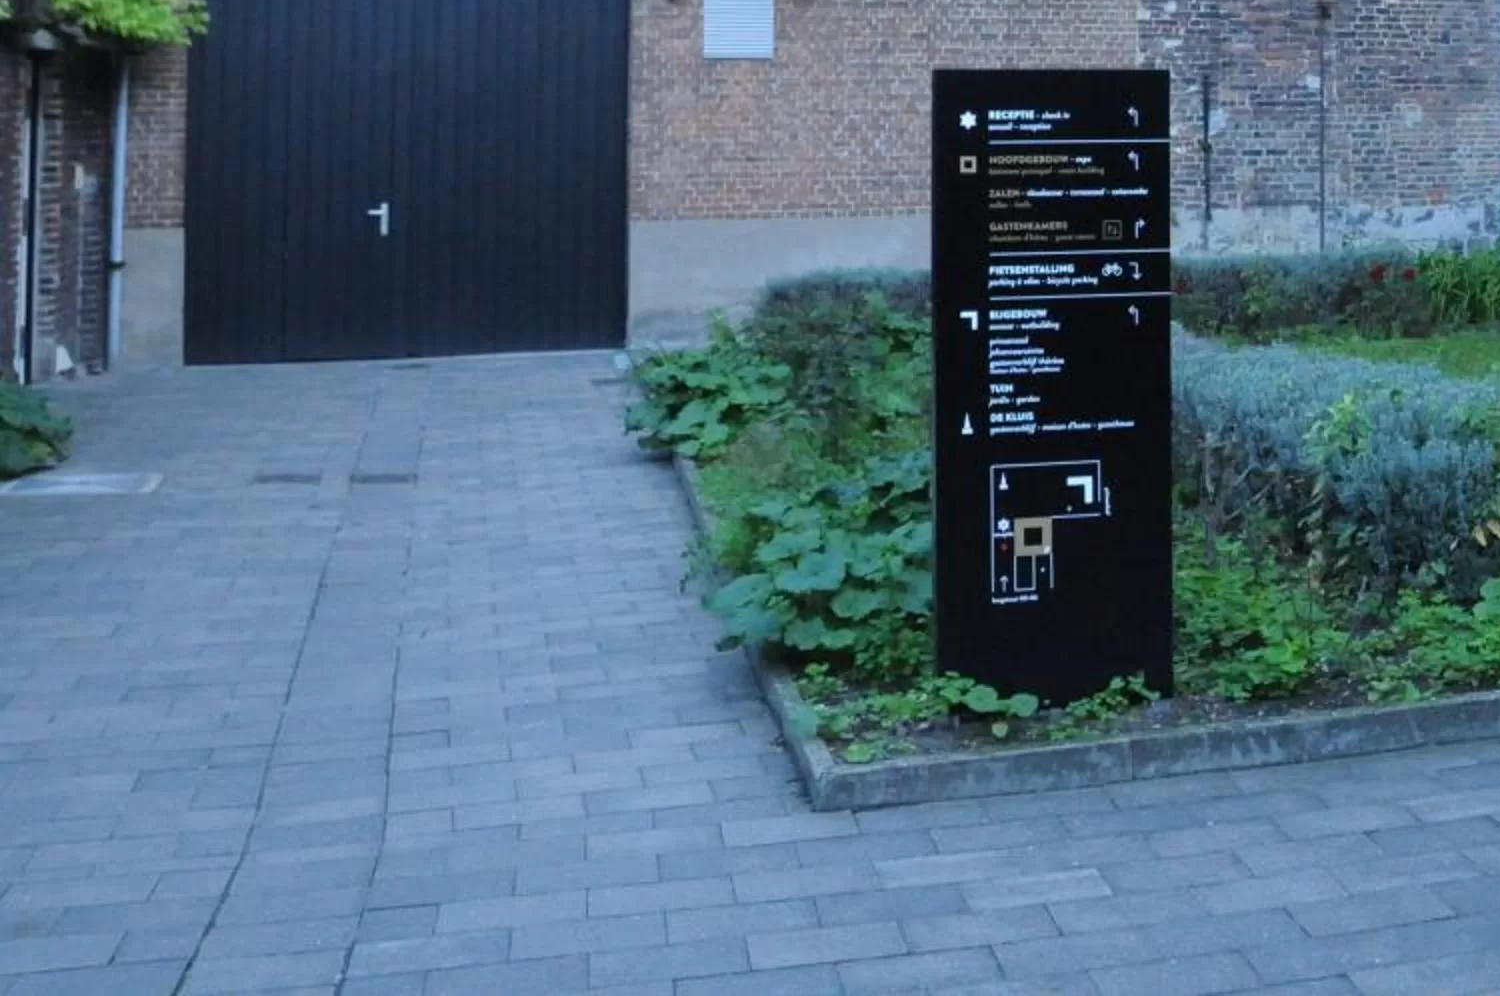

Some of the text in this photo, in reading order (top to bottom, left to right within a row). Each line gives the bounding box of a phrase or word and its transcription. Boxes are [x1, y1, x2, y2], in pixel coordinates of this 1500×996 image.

[988, 109, 1035, 121] RECEPTIE
[988, 154, 1069, 165] HOOFDGEBOUW
[987, 188, 1021, 199] ZALEN
[988, 220, 1069, 232] GASTENKAMERS
[988, 263, 1075, 276] FIETSENSTALLING
[989, 308, 1047, 320] BIJGEBOUW
[989, 383, 1014, 394] TUIN
[989, 411, 1035, 423] DE KLUIS
